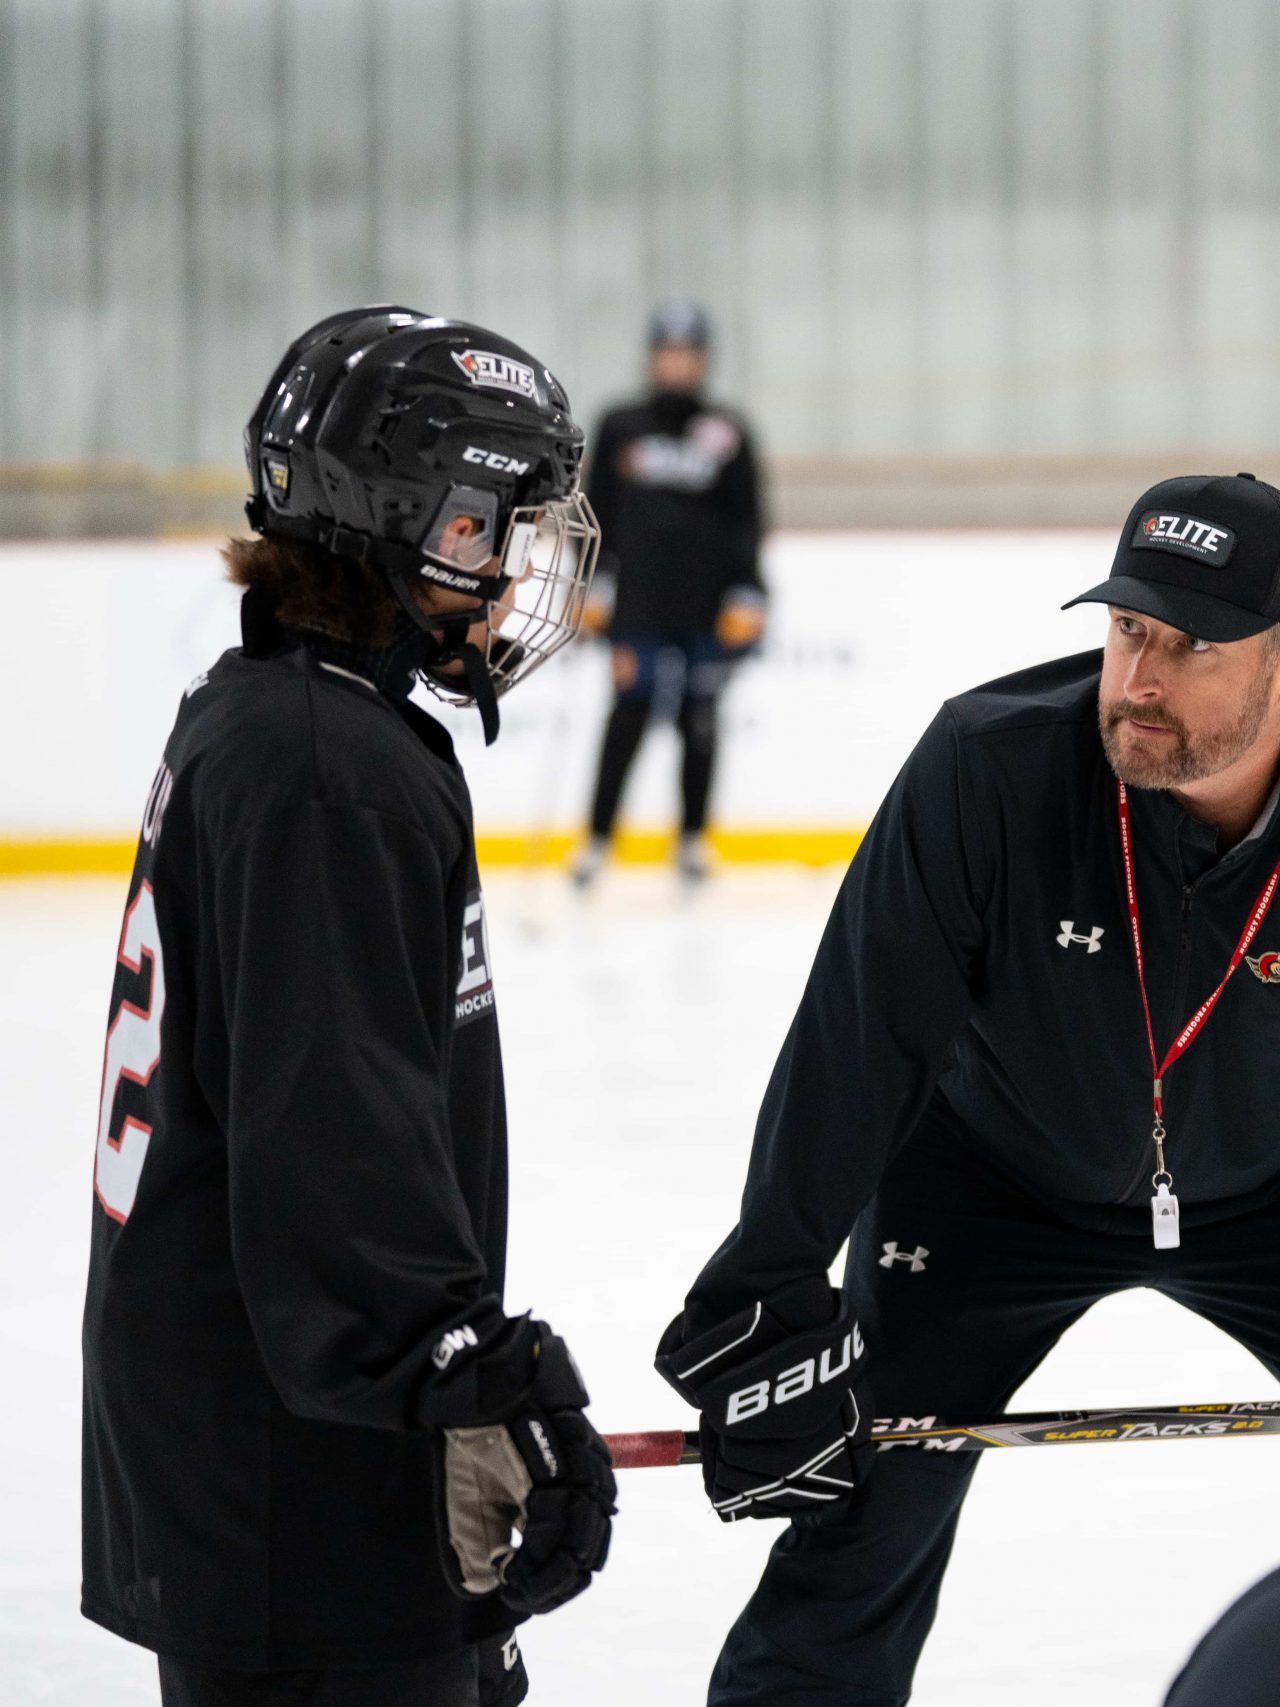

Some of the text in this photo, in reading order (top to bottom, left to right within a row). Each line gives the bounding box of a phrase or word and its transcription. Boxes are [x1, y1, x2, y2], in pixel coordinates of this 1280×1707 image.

[474, 355, 533, 390] ELITE
[463, 446, 530, 476] CCM
[1152, 515, 1228, 552] ELITE
[1240, 919, 1259, 955] HOCKEY
[455, 989, 494, 1019] HOCKE
[94, 878, 166, 1226] 2
[1043, 1429, 1118, 1440] SUPER
[1118, 1420, 1231, 1440] TACKS
